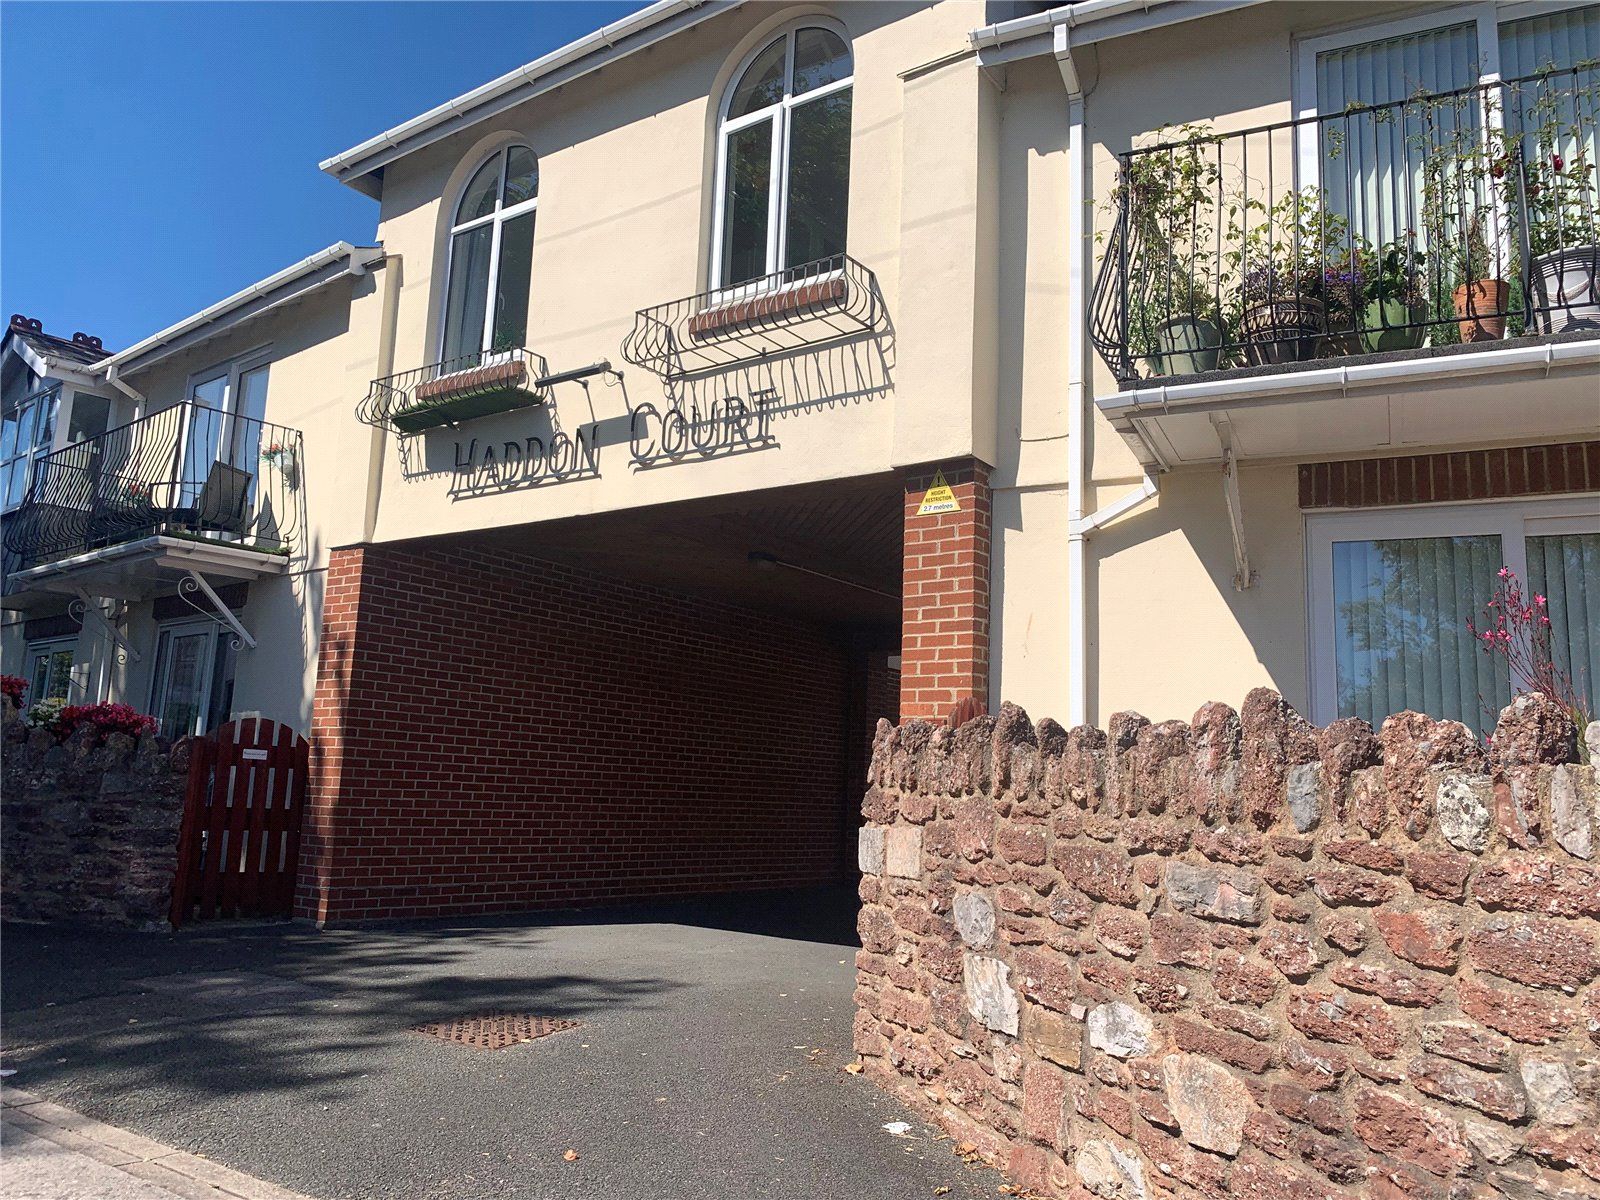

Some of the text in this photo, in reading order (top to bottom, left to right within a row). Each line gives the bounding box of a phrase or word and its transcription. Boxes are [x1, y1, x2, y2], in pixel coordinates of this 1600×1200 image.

[450, 387, 777, 491] HADDON COURT
[926, 495, 952, 503] RESTRICTION
